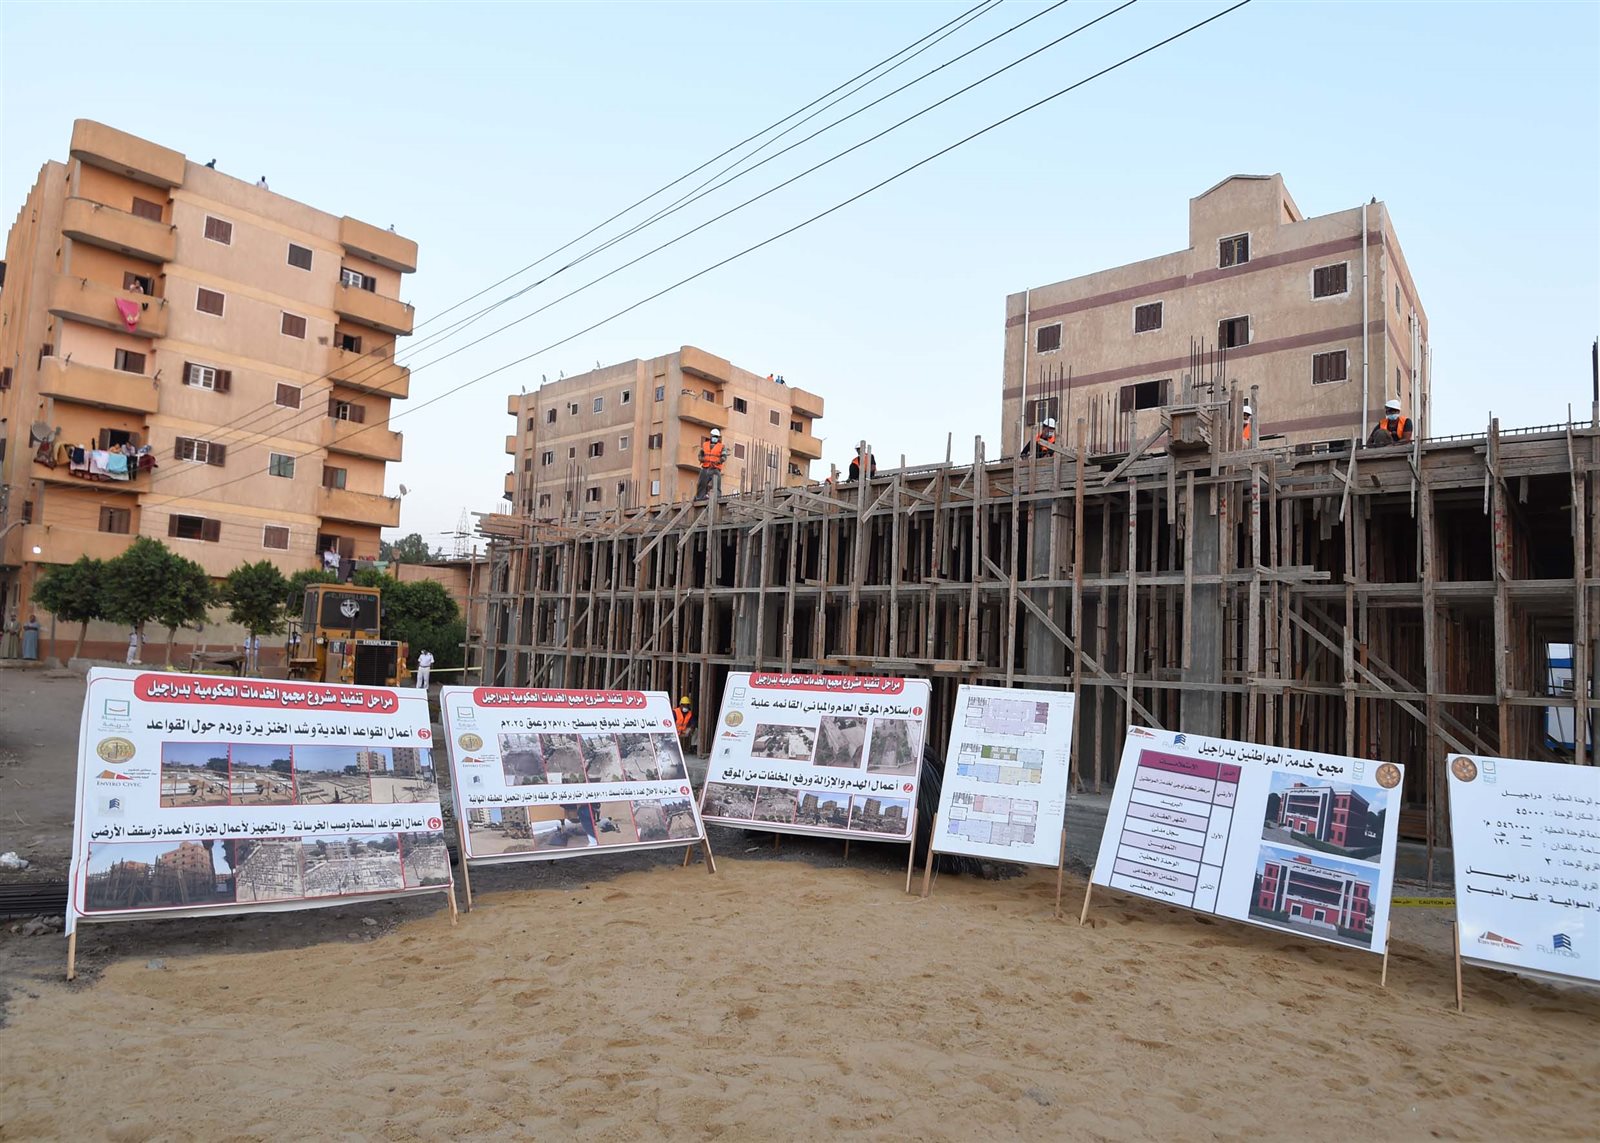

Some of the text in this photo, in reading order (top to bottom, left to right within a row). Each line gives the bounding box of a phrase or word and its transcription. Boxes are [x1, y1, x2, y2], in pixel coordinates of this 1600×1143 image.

[755, 674, 901, 691] مراحل تنفيذ مشروع مجمع الخدمات الحكومية بدراجيل
[147, 679, 393, 709] مراحل تنفيذ مشروع مجمع الخدمات الحكومية بدراجيل
[481, 690, 643, 706] مراحل تنفيذ مشروع مجمع الخدمات الحكومية بدراجيل
[836, 703, 857, 714] العام
[857, 702, 883, 716] الموقع
[146, 718, 190, 734] القواعد
[191, 718, 216, 734] حول
[218, 721, 243, 735] وردم
[245, 719, 292, 737] الخنزيرة
[318, 722, 351, 739] العادية
[526, 717, 547, 730] وعمق
[572, 718, 598, 730] بمسطح
[599, 717, 620, 730] للموقع
[622, 717, 640, 730] الحفر
[640, 717, 659, 730] أعمال
[352, 724, 387, 739] القواعد
[388, 724, 413, 740] أعمال
[1198, 741, 1237, 760] بدراجيل
[1237, 747, 1284, 766] المواطنين
[1285, 754, 1315, 769] خدمة
[721, 767, 745, 780] الموقع
[744, 770, 757, 779] من
[1316, 761, 1344, 777] مجمع
[759, 770, 792, 783] المخلفات
[792, 774, 813, 787] ورفع
[814, 775, 845, 790] والإزالة
[846, 779, 872, 791] الهدم
[875, 779, 899, 791] أعمال
[1516, 808, 1544, 816] ٤٥٠٠٠
[158, 821, 195, 837] الأعمدة
[220, 819, 249, 835] لأعمال
[293, 820, 329, 833] الخرسانة
[330, 820, 350, 831] وصب
[351, 817, 377, 829] المسلحة
[377, 816, 405, 830] القواعد
[405, 814, 425, 830] أعمال
[1496, 821, 1531, 830] ٥٤٦٠٠٠
[127, 825, 157, 839] وسقف
[194, 822, 218, 837] نجارة
